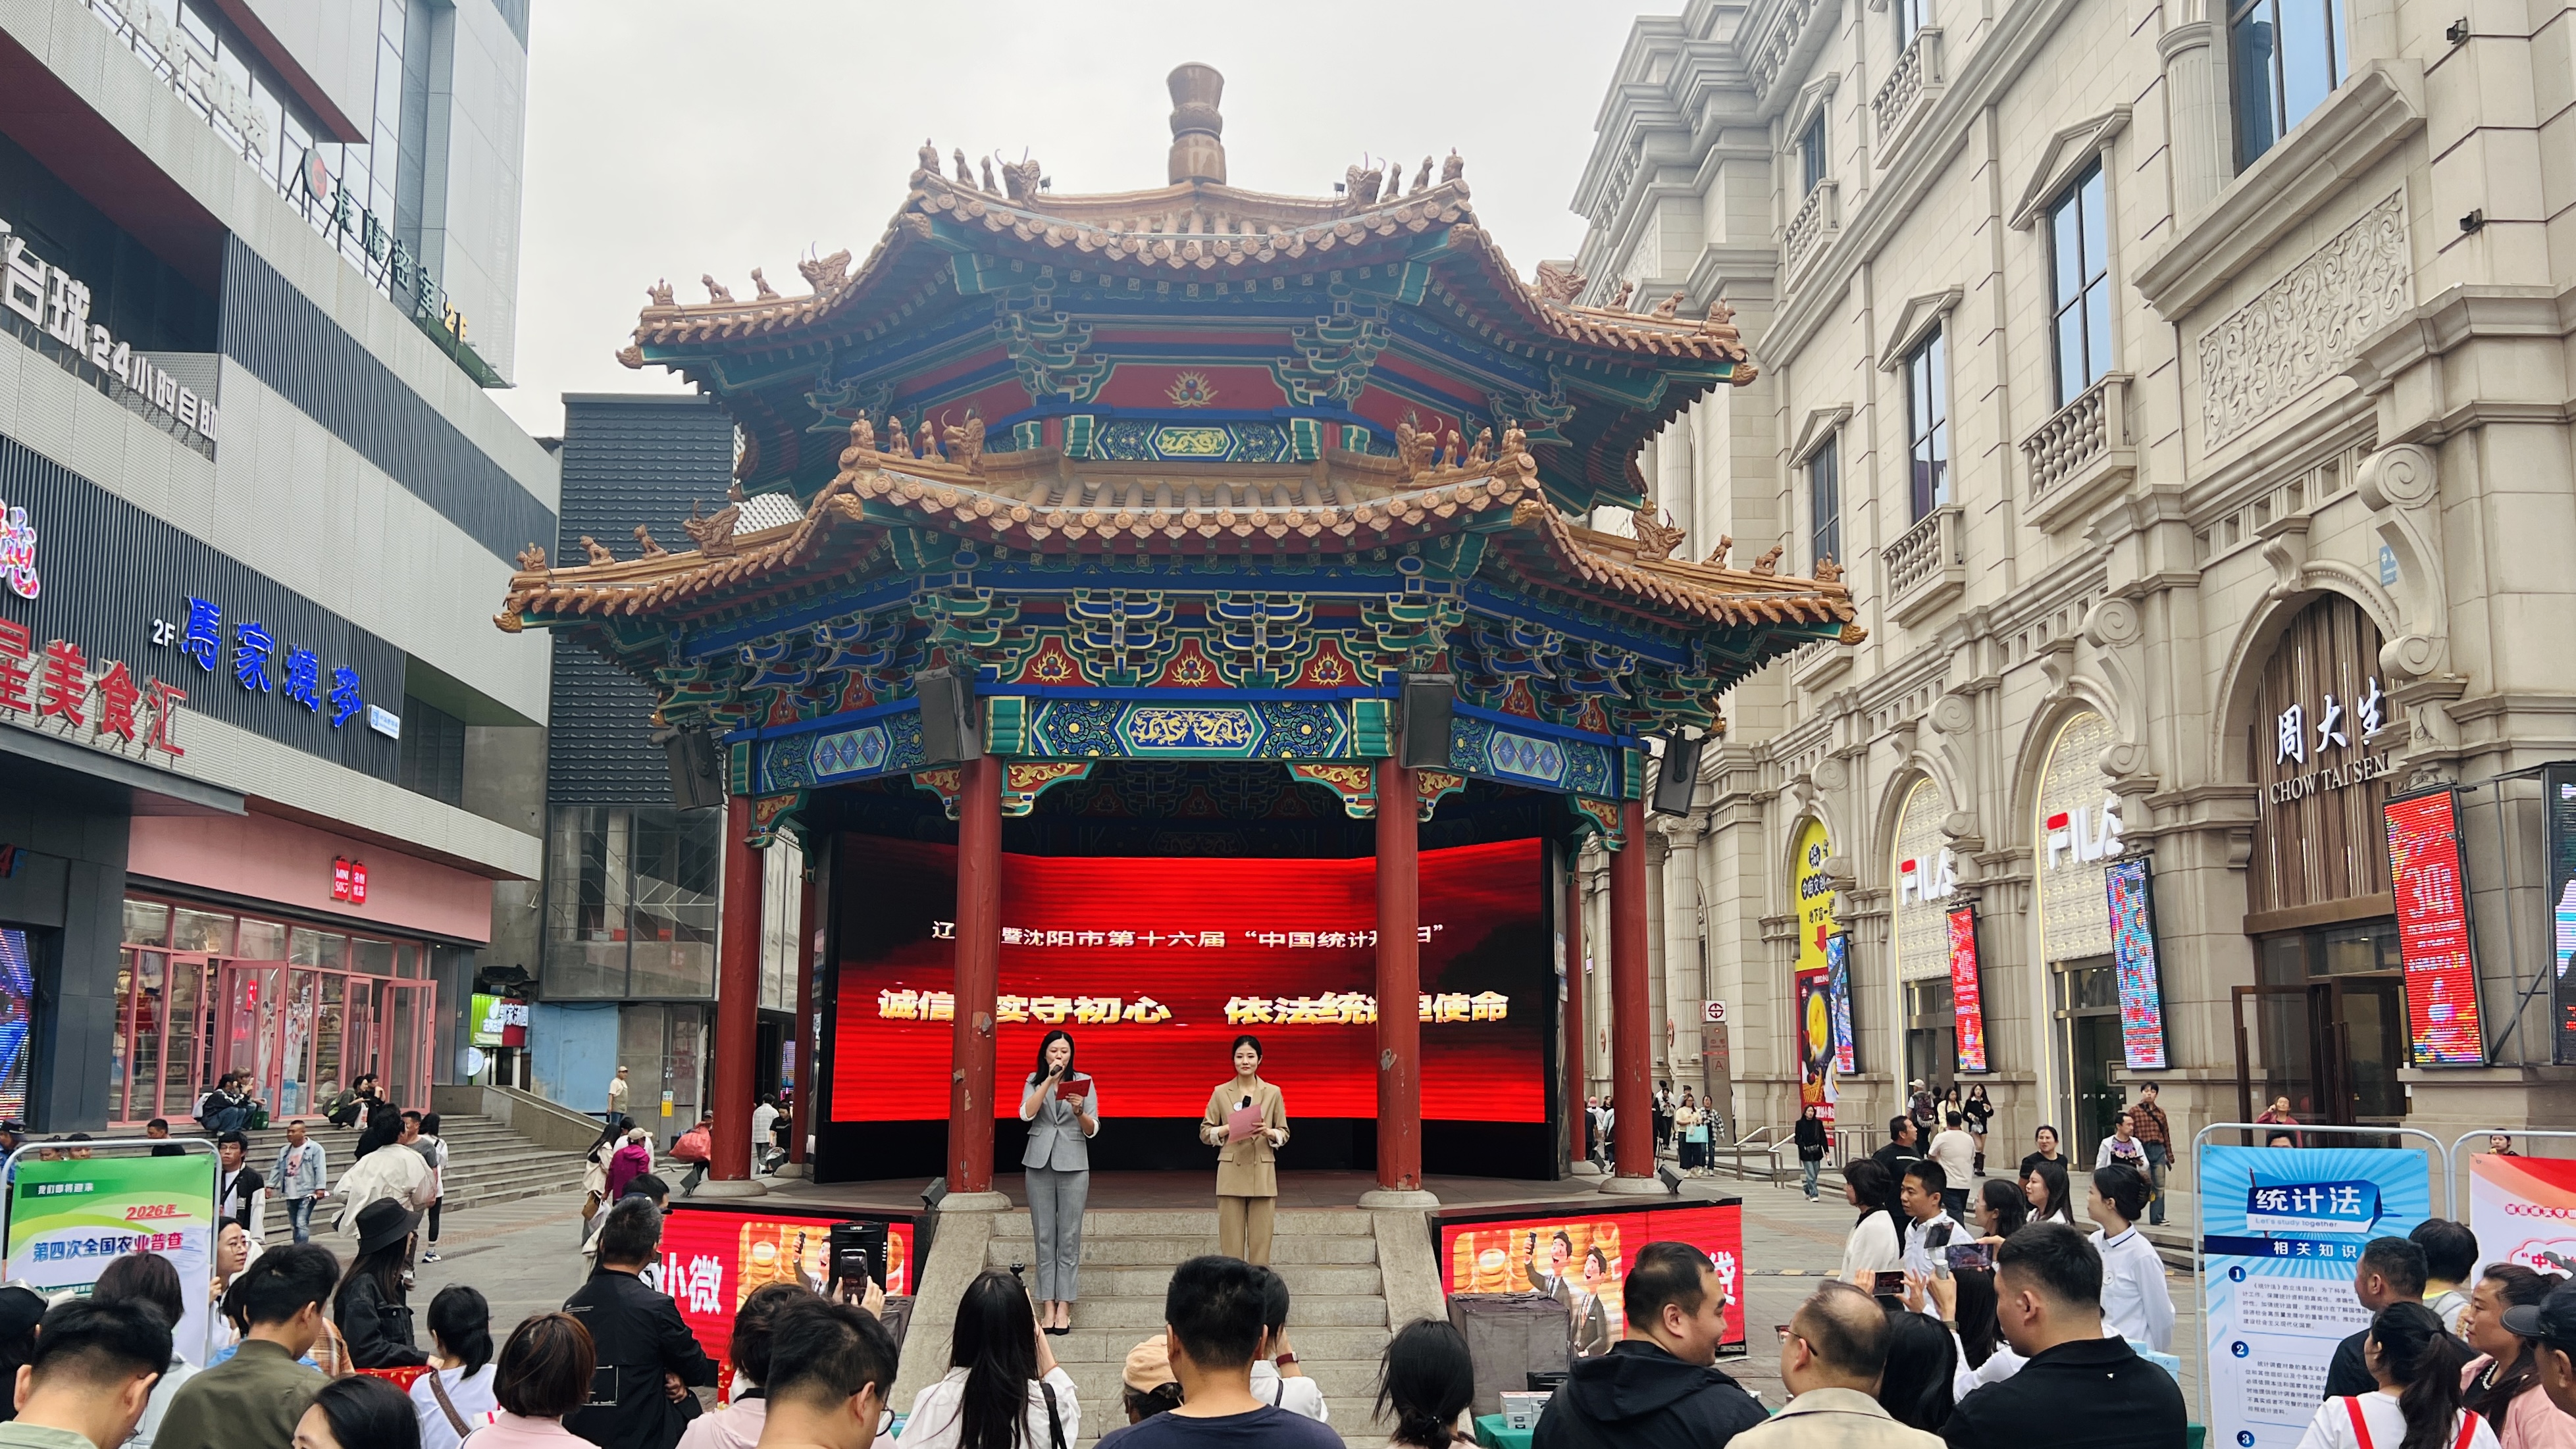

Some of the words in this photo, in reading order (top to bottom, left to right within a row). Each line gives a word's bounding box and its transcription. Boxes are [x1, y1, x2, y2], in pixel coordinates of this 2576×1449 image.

[5, 237, 91, 356] 台球
[444, 301, 468, 345] 2F
[153, 618, 176, 647] 2F
[2277, 676, 2383, 765] 周大生
[2271, 772, 2317, 805] CHOW
[2321, 763, 2352, 791] TAI
[2047, 796, 2125, 870] FILA
[336, 868, 349, 880] MINI
[1900, 848, 1954, 907] FILA
[931, 920, 1225, 948] 辽暨沈阳市第十六届
[1245, 923, 1443, 949] “中国统计日”
[877, 988, 1173, 1025] 诚信实守初心
[1714, 1060, 1724, 1071] A
[38, 1182, 94, 1195] 我们即将迎来
[2255, 1186, 2362, 1215] 统计法
[125, 1204, 178, 1220] 2026年
[2277, 1219, 2300, 1227] study
[2302, 1220, 2338, 1229] together
[33, 1231, 184, 1263] 第四次全国农业普查
[2273, 1240, 2357, 1259] 相关知识
[661, 1252, 723, 1315] 小微
[2234, 1269, 2241, 1280] 1
[2236, 1344, 2245, 1355] 2
[2242, 1433, 2250, 1444] 3
